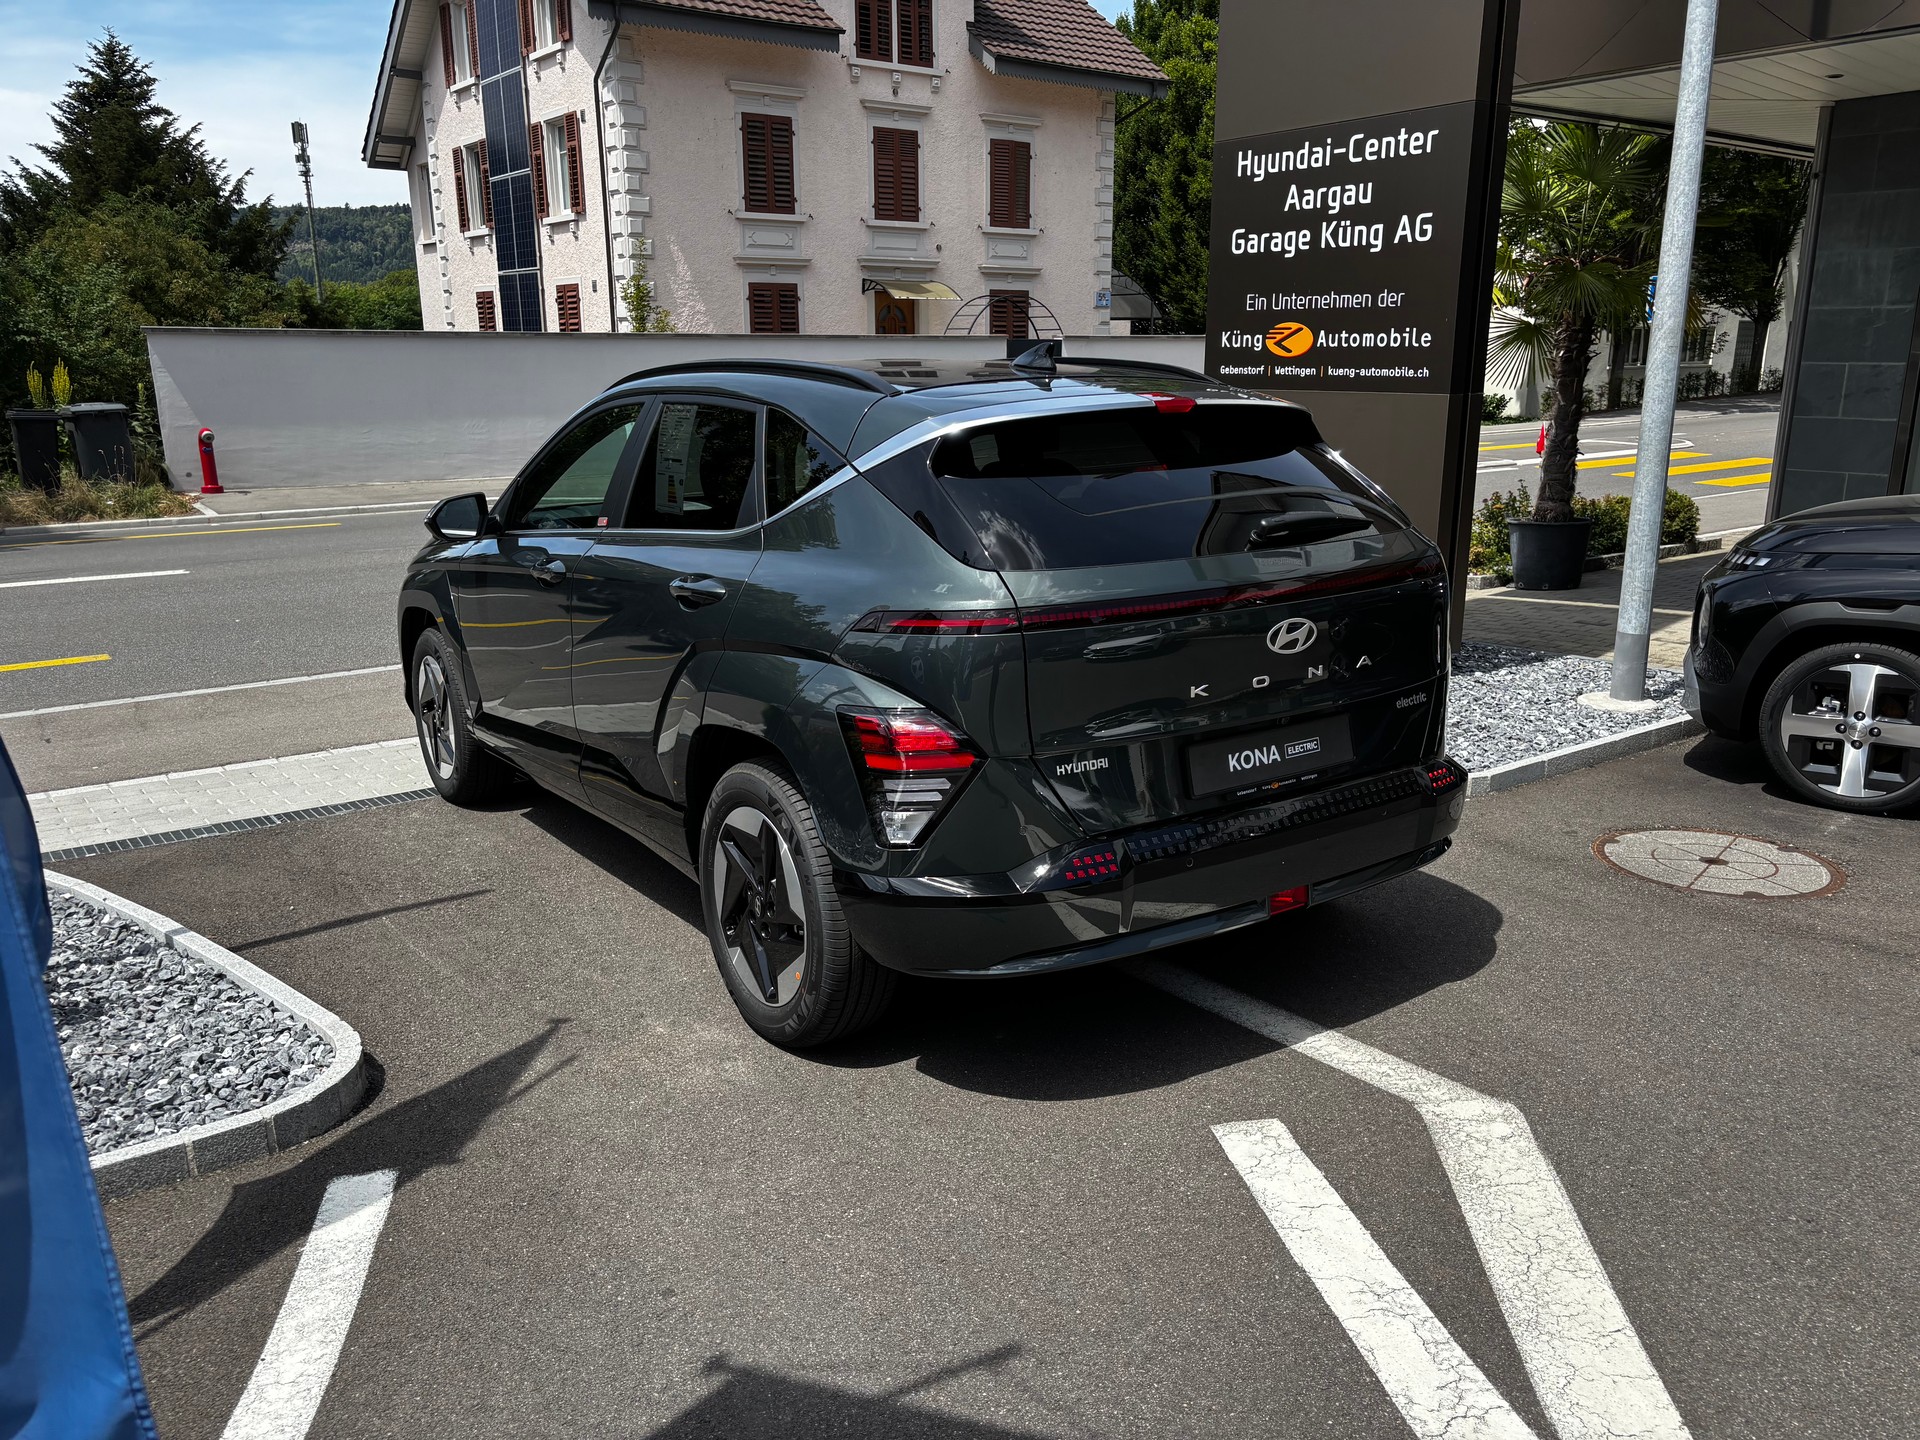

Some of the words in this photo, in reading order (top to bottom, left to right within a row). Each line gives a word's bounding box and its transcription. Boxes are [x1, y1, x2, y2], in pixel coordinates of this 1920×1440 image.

[1237, 128, 1440, 182] Hyundai-Center
[1283, 181, 1373, 215] Aargau
[1231, 228, 1311, 258] Garage
[1320, 219, 1384, 253] Küng
[1393, 212, 1434, 244] AG
[1246, 293, 1267, 311] Ein
[1272, 290, 1372, 311] Unternehmen
[1377, 288, 1406, 308] der
[1221, 330, 1263, 351] Küng
[1316, 327, 1432, 348] Automobile
[1219, 364, 1265, 375] Gebenstorf
[1274, 365, 1317, 377] Wettingen
[1327, 365, 1430, 378] kueng-automobile.ch
[1395, 691, 1427, 709] electric
[1056, 757, 1109, 776] HYUNDAI
[1228, 744, 1282, 773] KONA
[1287, 741, 1318, 755] ELECTRIC
